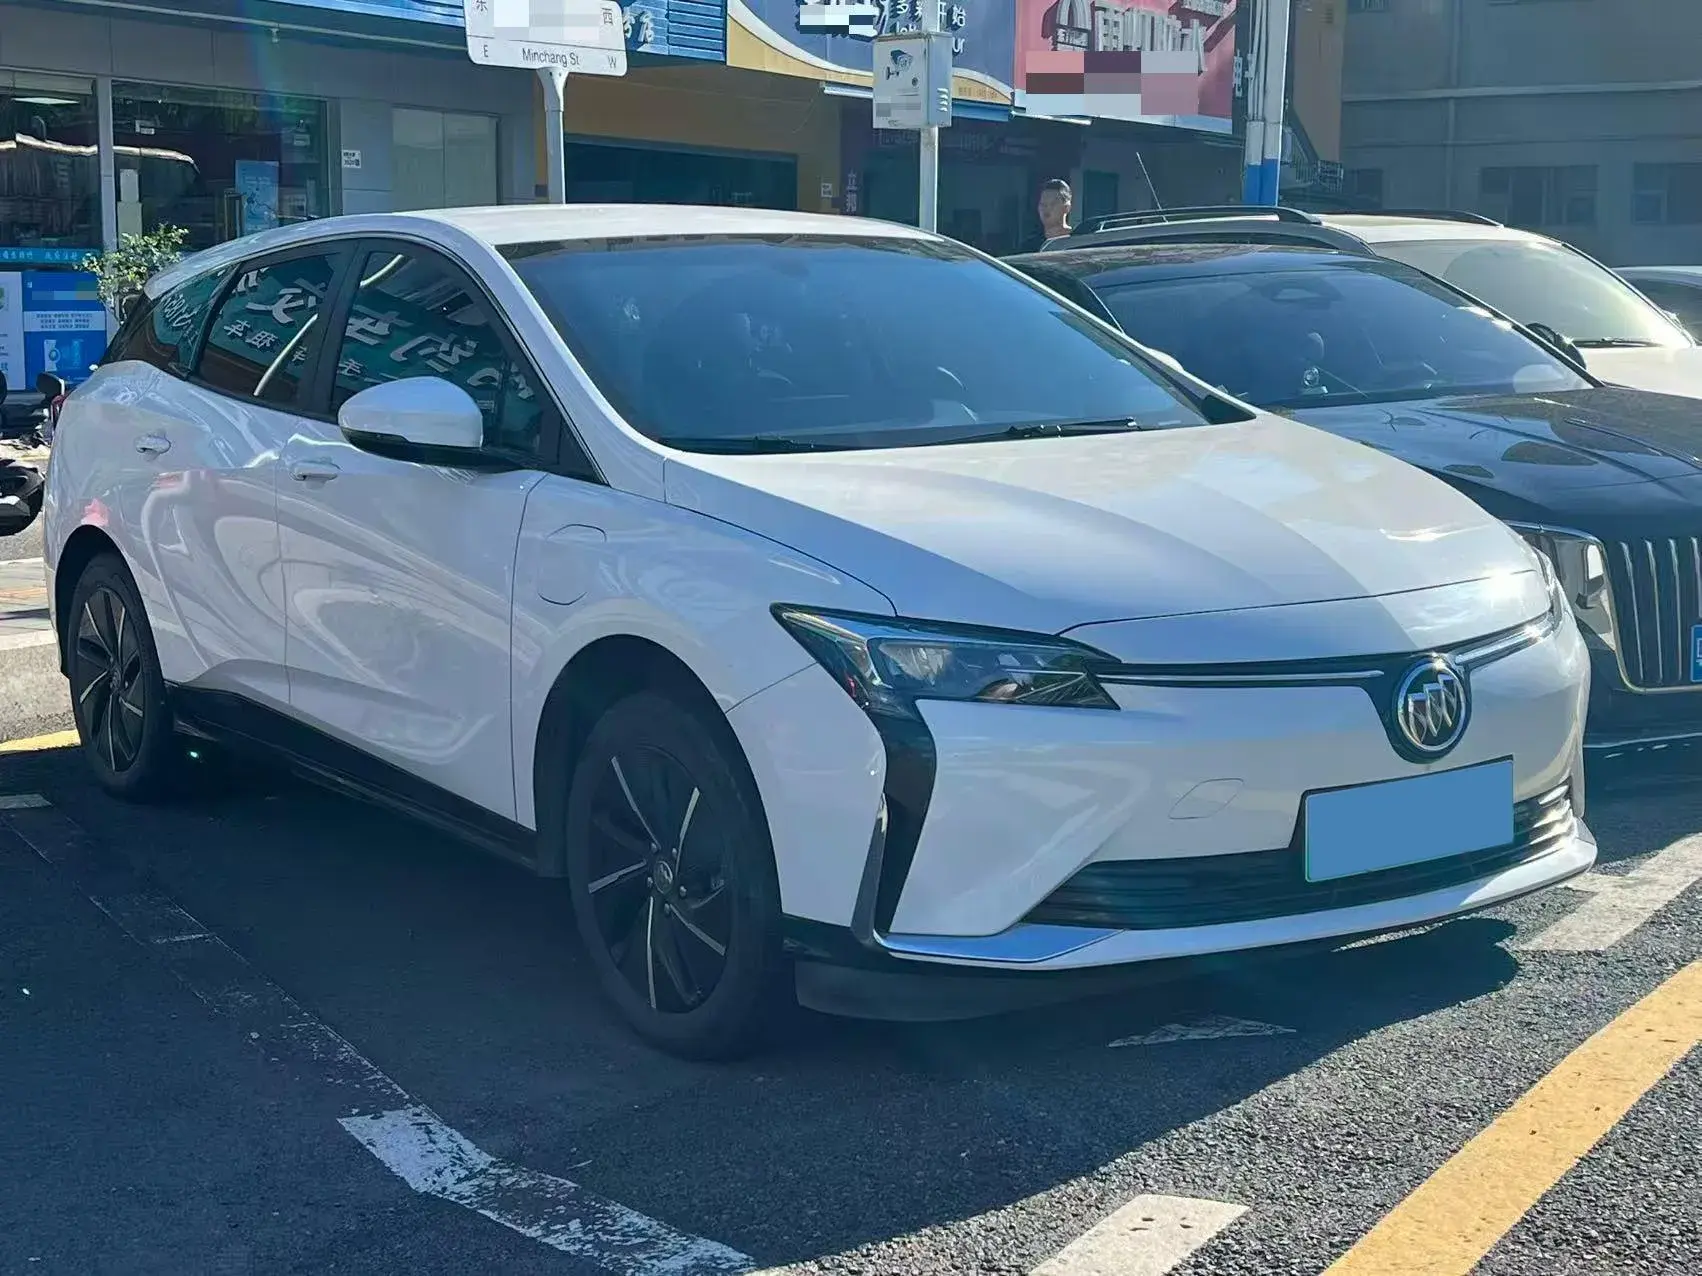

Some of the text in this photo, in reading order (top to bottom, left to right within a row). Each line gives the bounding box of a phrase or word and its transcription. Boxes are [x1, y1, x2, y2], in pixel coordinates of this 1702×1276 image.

[602, 8, 613, 25] 西
[483, 45, 489, 57] E
[522, 48, 580, 67] Minchang St
[607, 56, 617, 69] W
